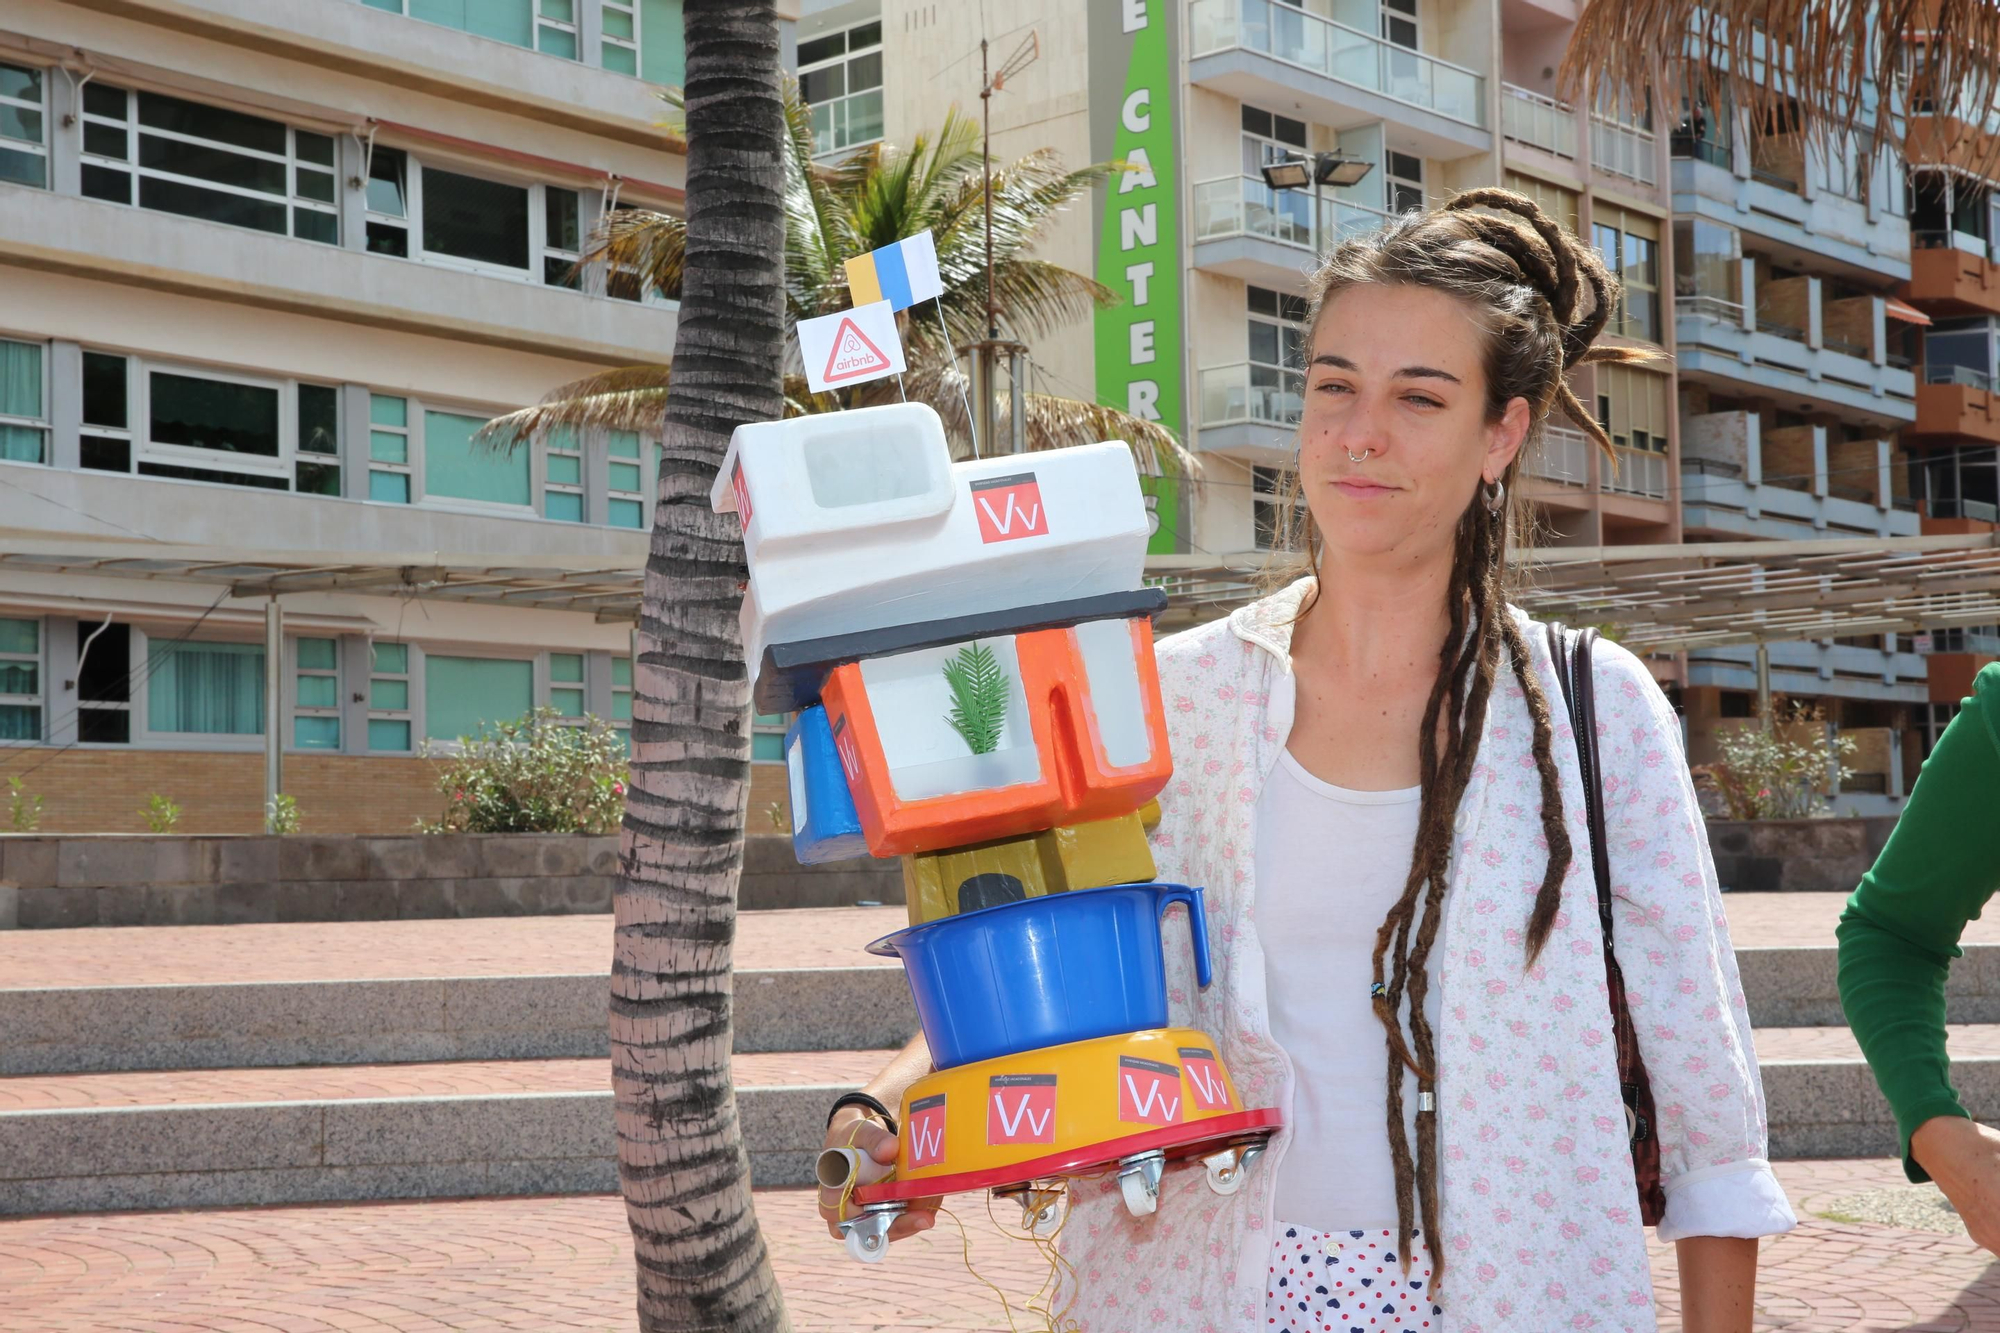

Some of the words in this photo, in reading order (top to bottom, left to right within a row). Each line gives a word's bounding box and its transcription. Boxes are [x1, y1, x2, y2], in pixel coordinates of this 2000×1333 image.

[836, 352, 875, 371] airbnb
[978, 492, 1038, 535] Vv
[838, 736, 859, 781] Vv
[1124, 1074, 1179, 1122] Vv
[1186, 1064, 1228, 1105] Vv
[994, 1093, 1051, 1136] Vv
[910, 1116, 942, 1160] Vv
